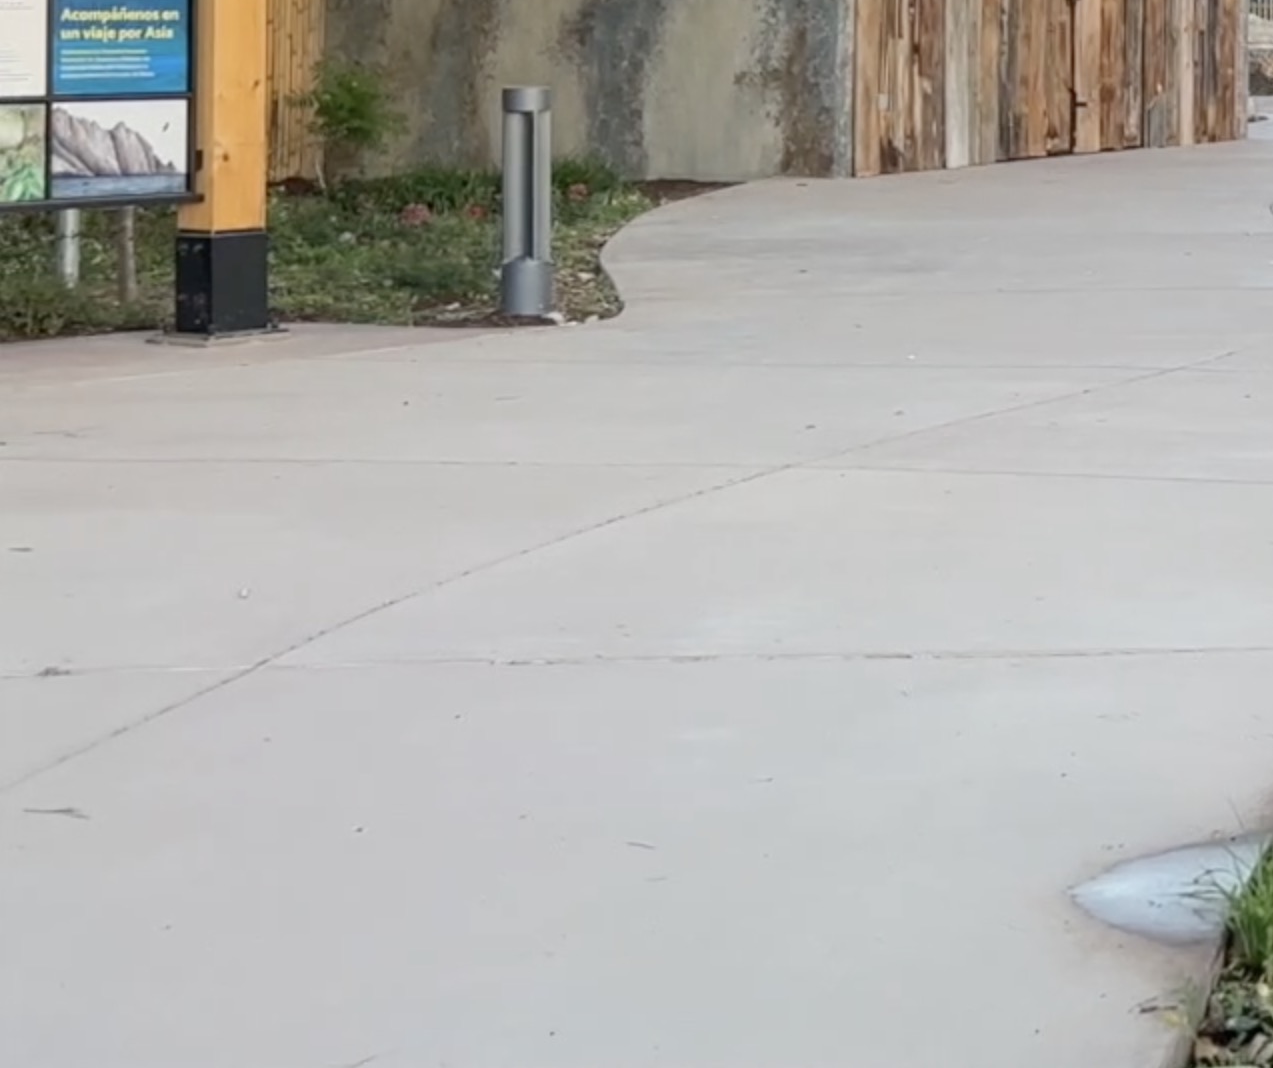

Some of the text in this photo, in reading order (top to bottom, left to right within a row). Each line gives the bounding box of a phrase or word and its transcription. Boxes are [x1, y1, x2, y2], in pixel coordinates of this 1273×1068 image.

[162, 10, 180, 21] en
[61, 26, 174, 43] un viaje por Asia
